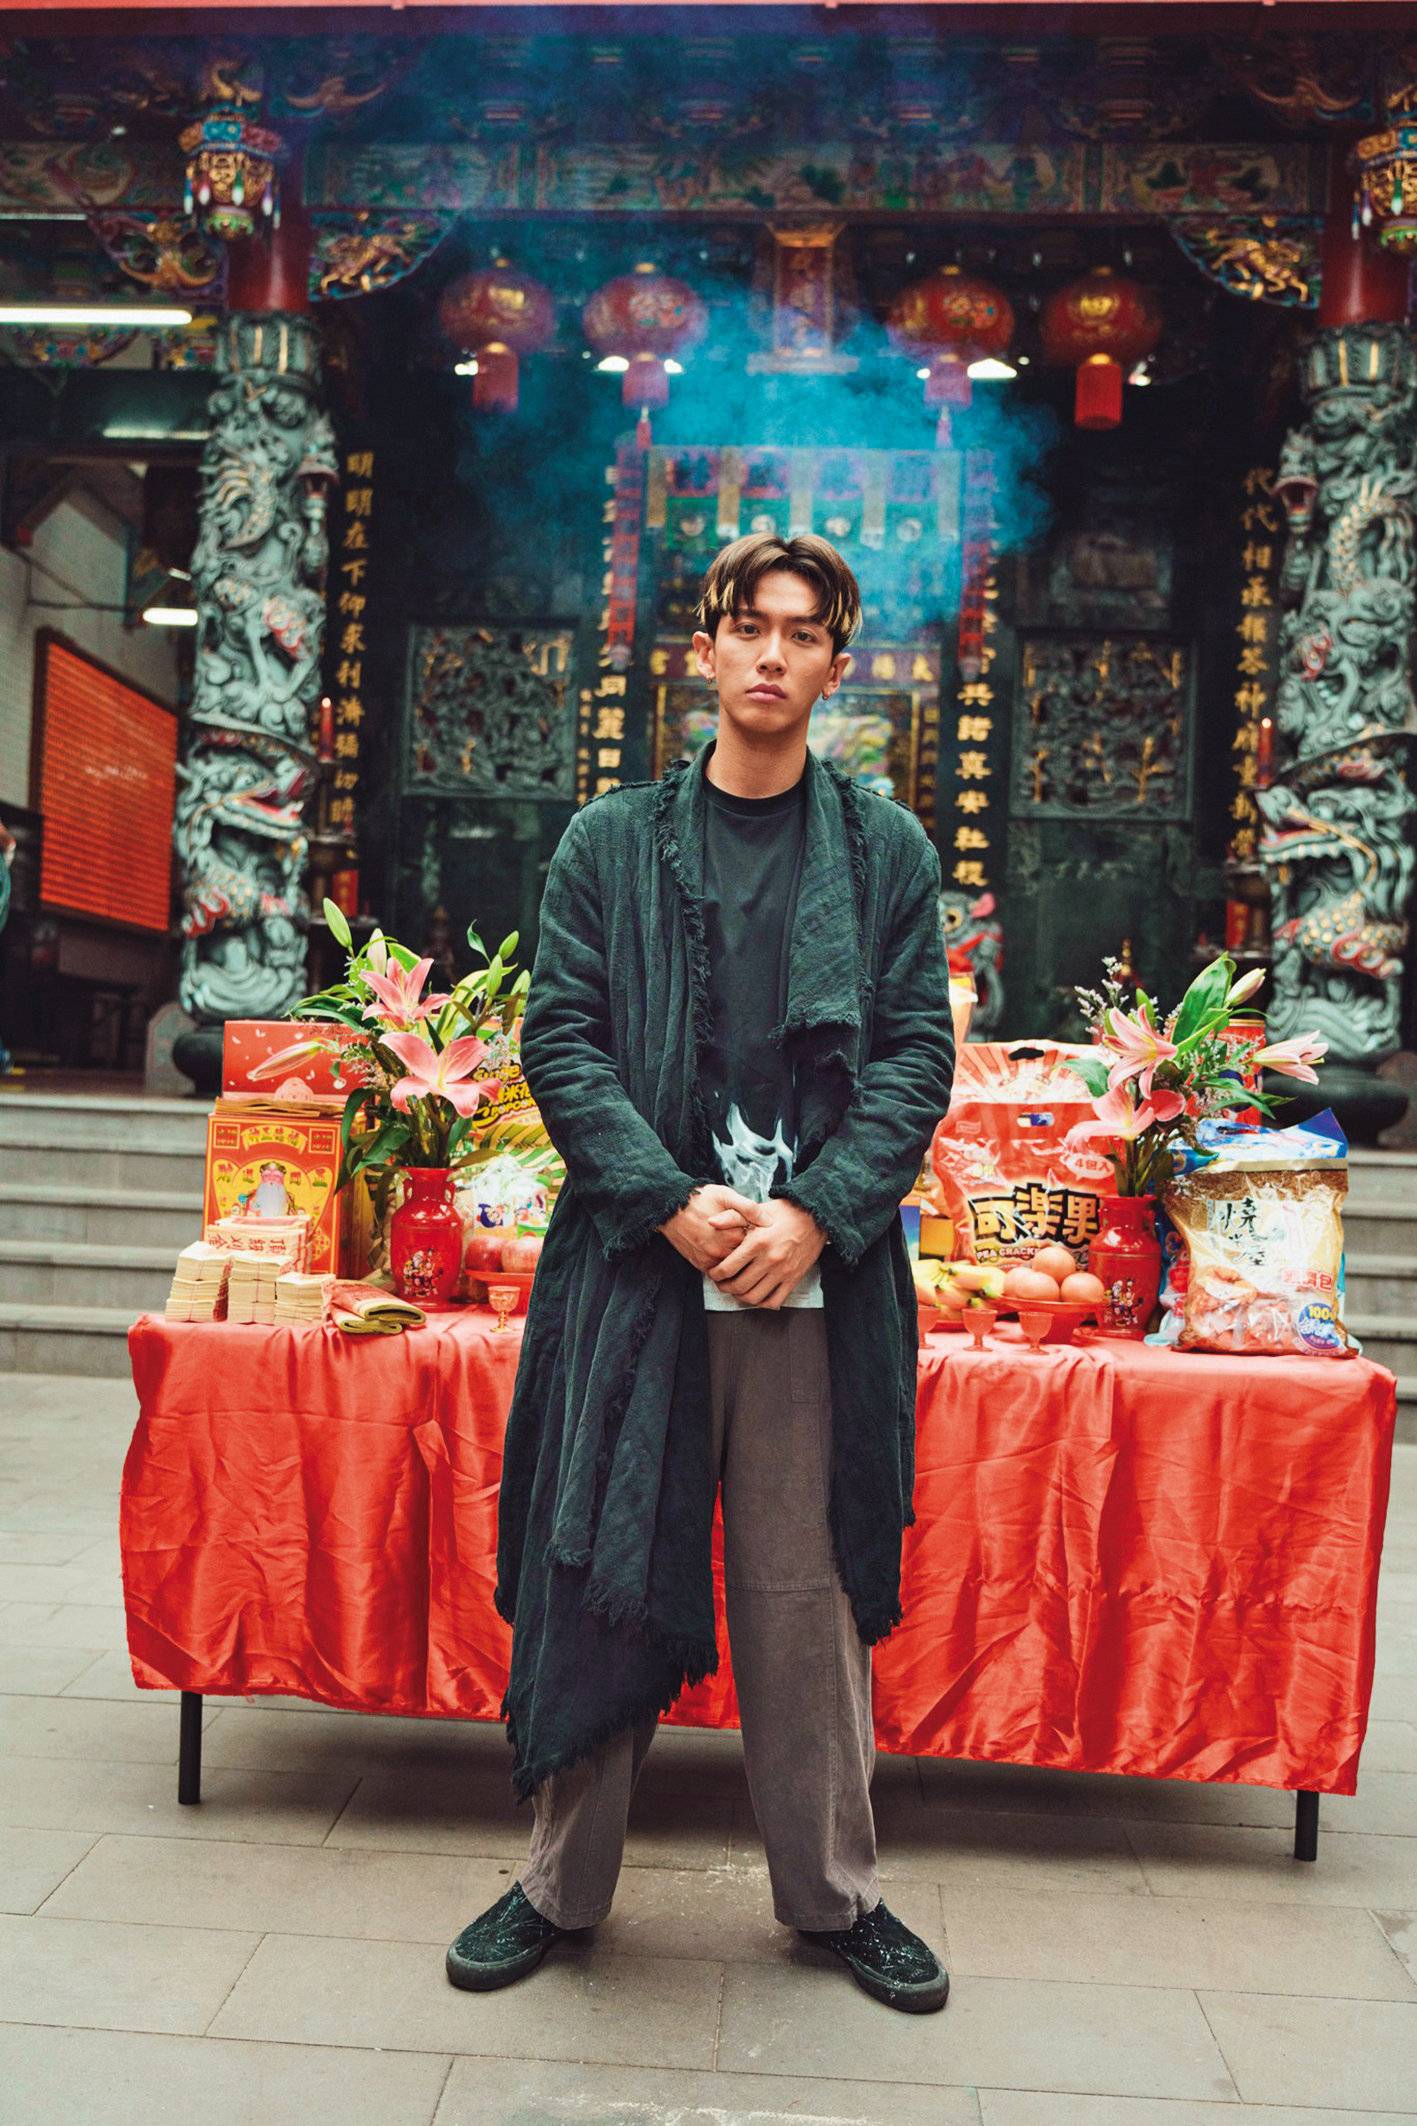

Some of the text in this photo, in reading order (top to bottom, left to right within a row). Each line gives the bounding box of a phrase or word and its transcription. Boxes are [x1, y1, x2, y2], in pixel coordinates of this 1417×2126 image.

[490, 1096, 537, 1118] POPCOR
[1074, 1159, 1111, 1173] 4包入
[976, 1246, 1041, 1261] PEA CRACKE
